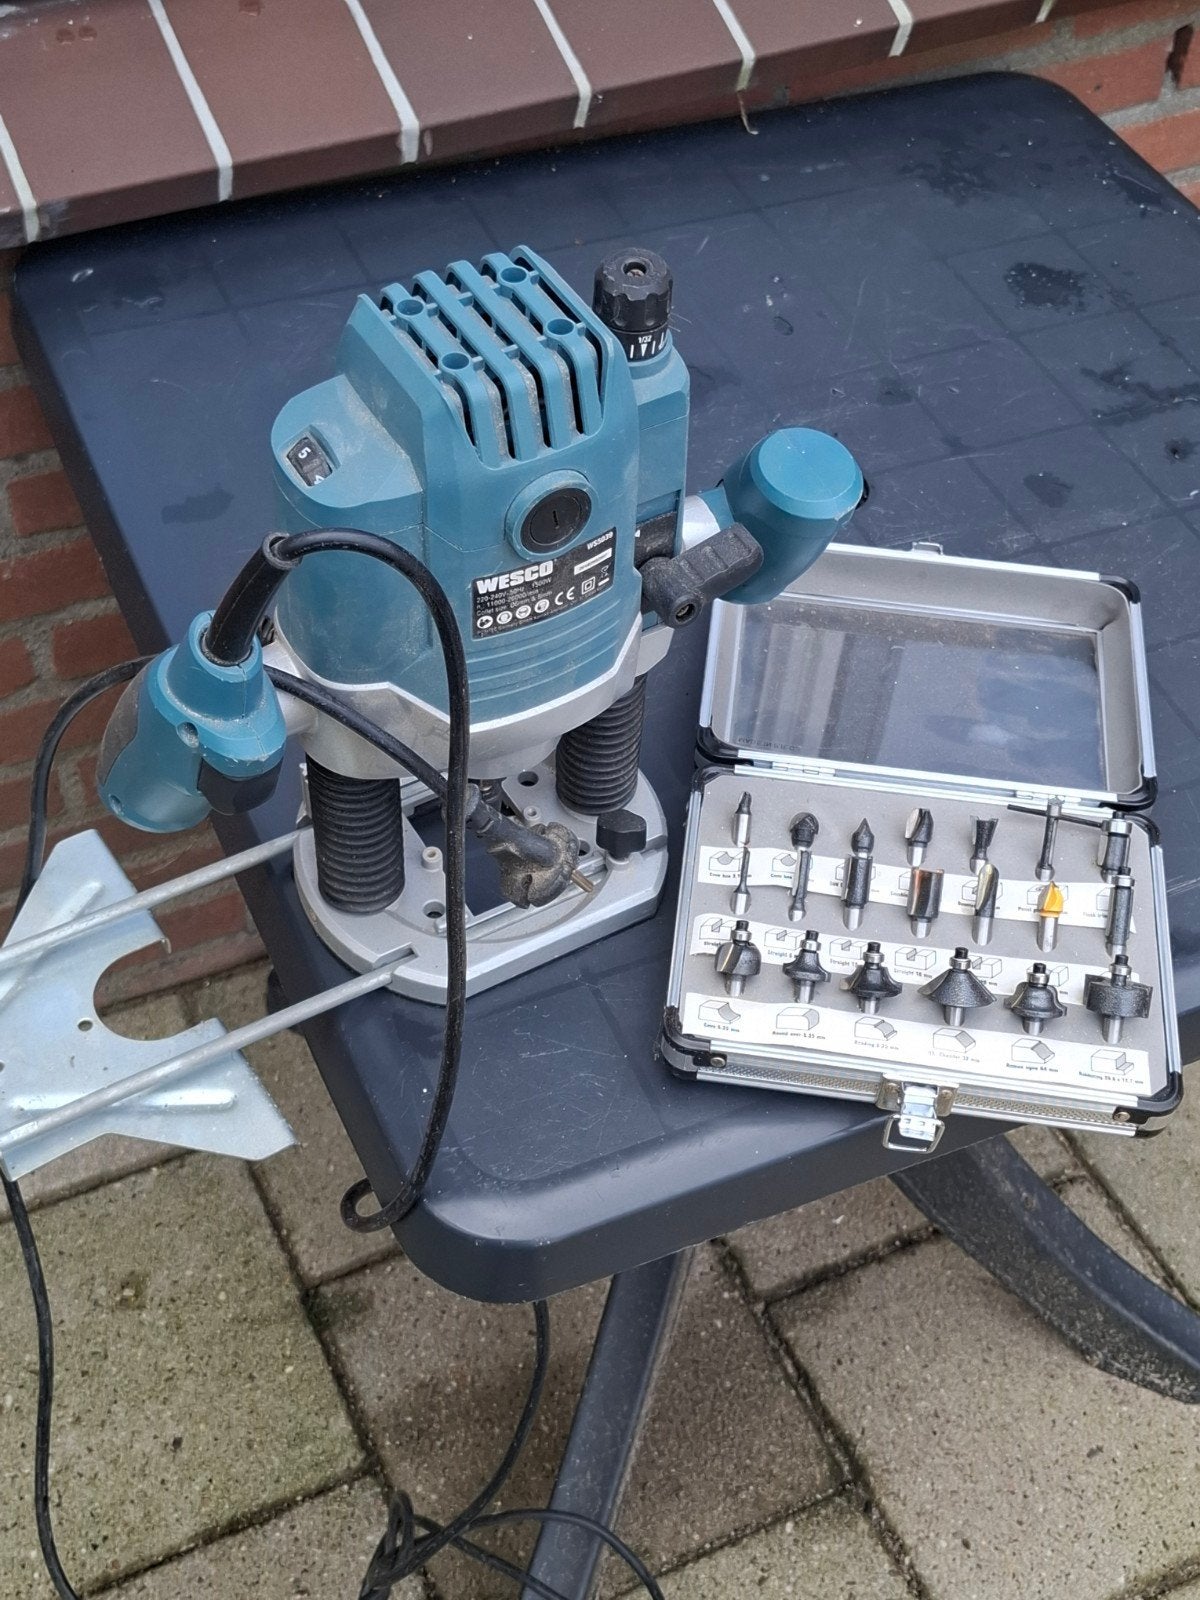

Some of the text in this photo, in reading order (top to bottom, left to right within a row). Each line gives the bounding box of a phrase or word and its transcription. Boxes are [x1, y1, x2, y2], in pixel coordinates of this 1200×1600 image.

[298, 447, 311, 459] 5
[586, 531, 614, 550] WS5039
[476, 560, 554, 594] WESCO
